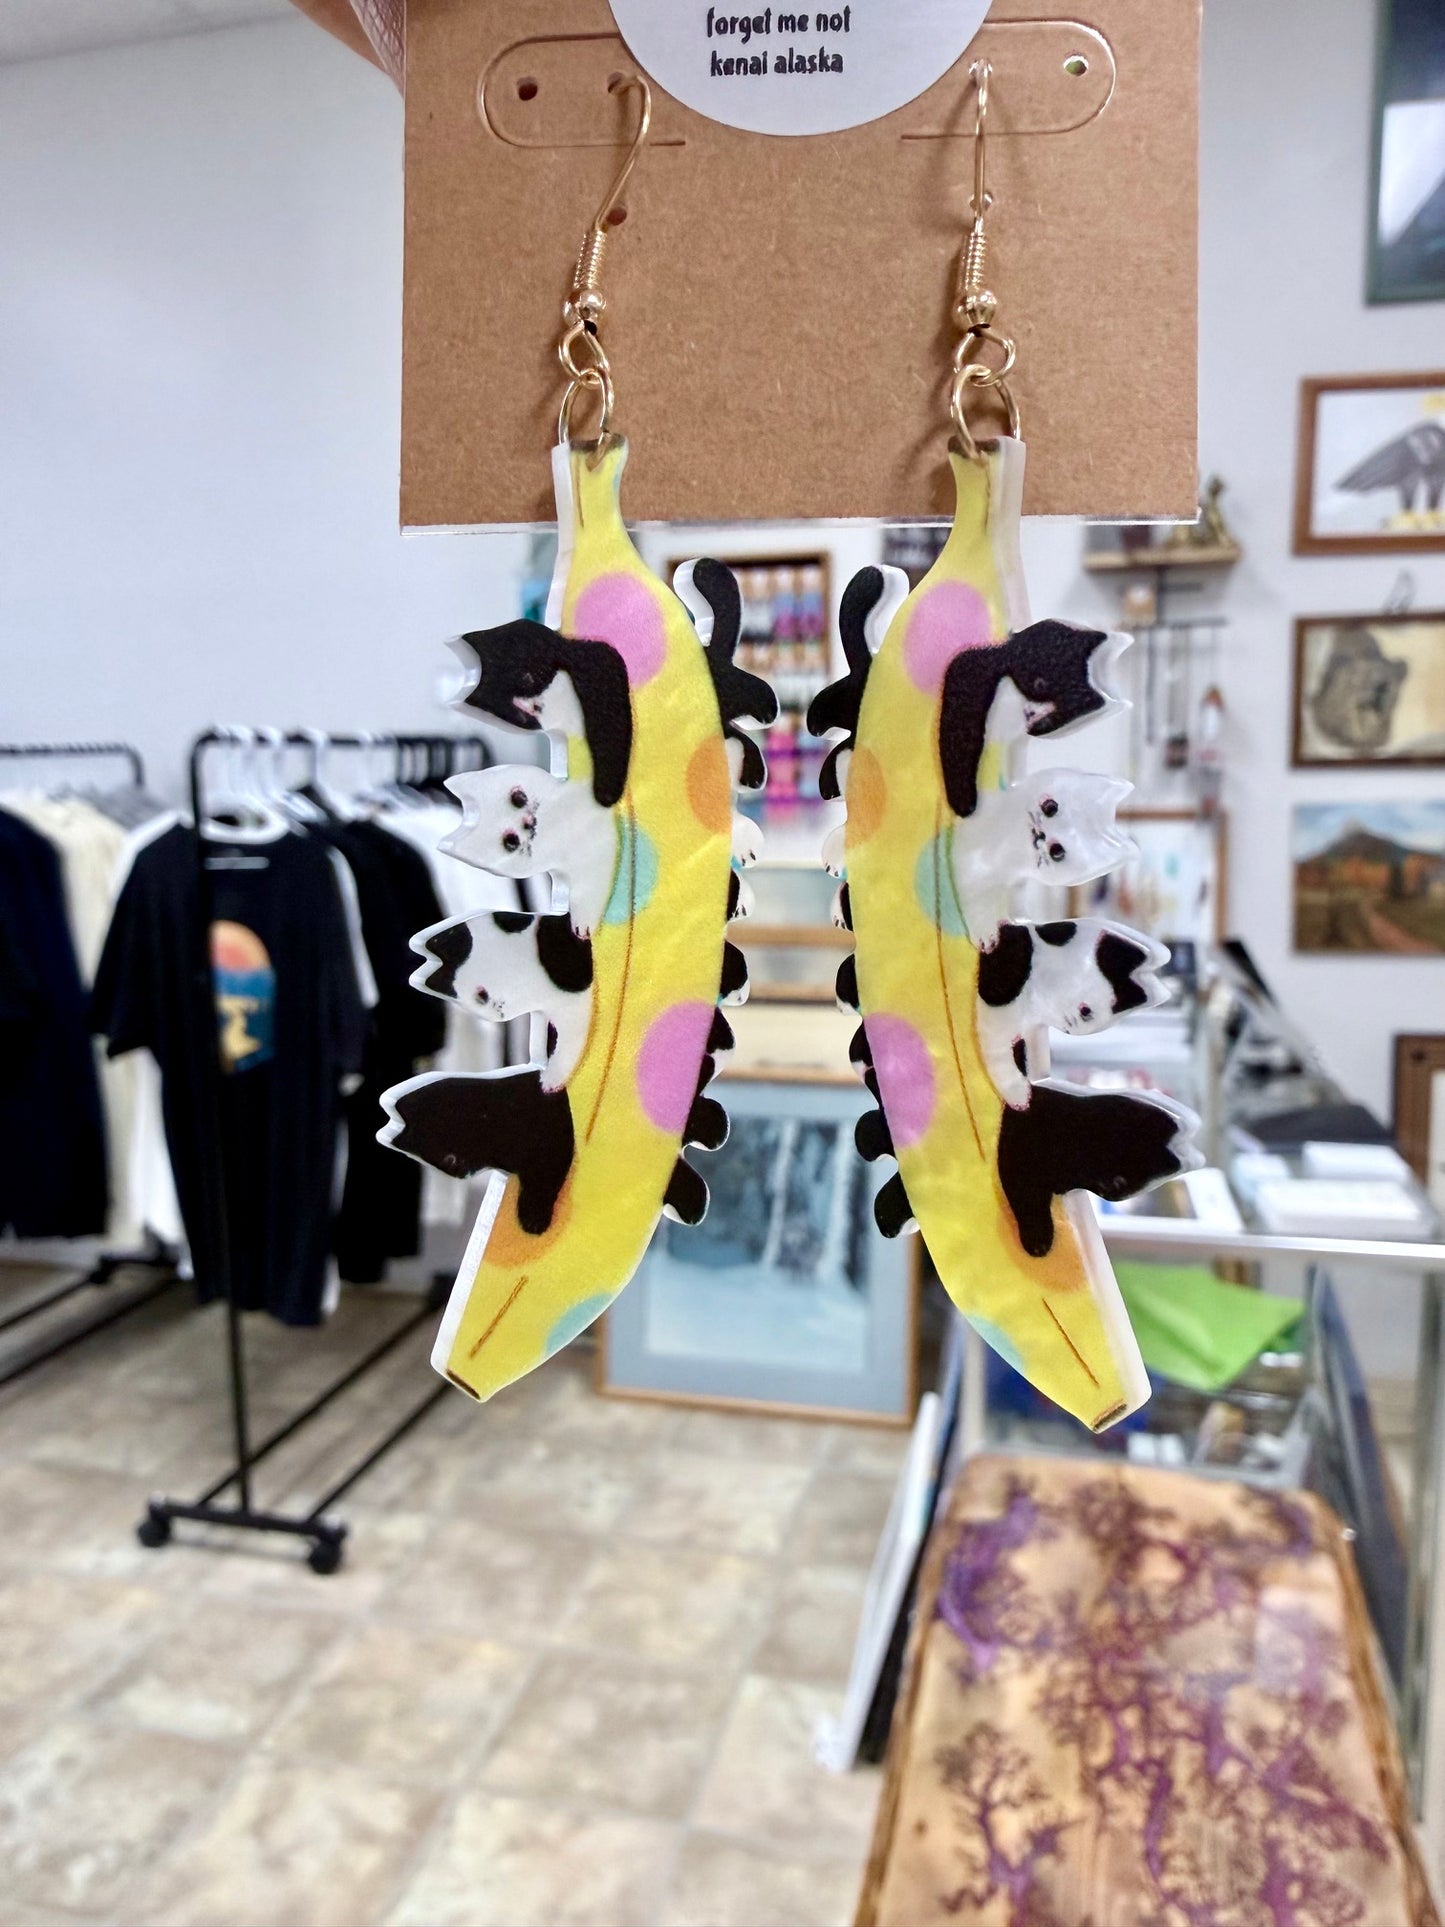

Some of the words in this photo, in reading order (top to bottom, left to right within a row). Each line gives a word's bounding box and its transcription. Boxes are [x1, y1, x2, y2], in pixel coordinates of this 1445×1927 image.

[706, 7, 772, 44] forget
[777, 13, 810, 34] me
[815, 5, 852, 33] not
[710, 51, 768, 77] kenai
[773, 46, 844, 75] alaska
